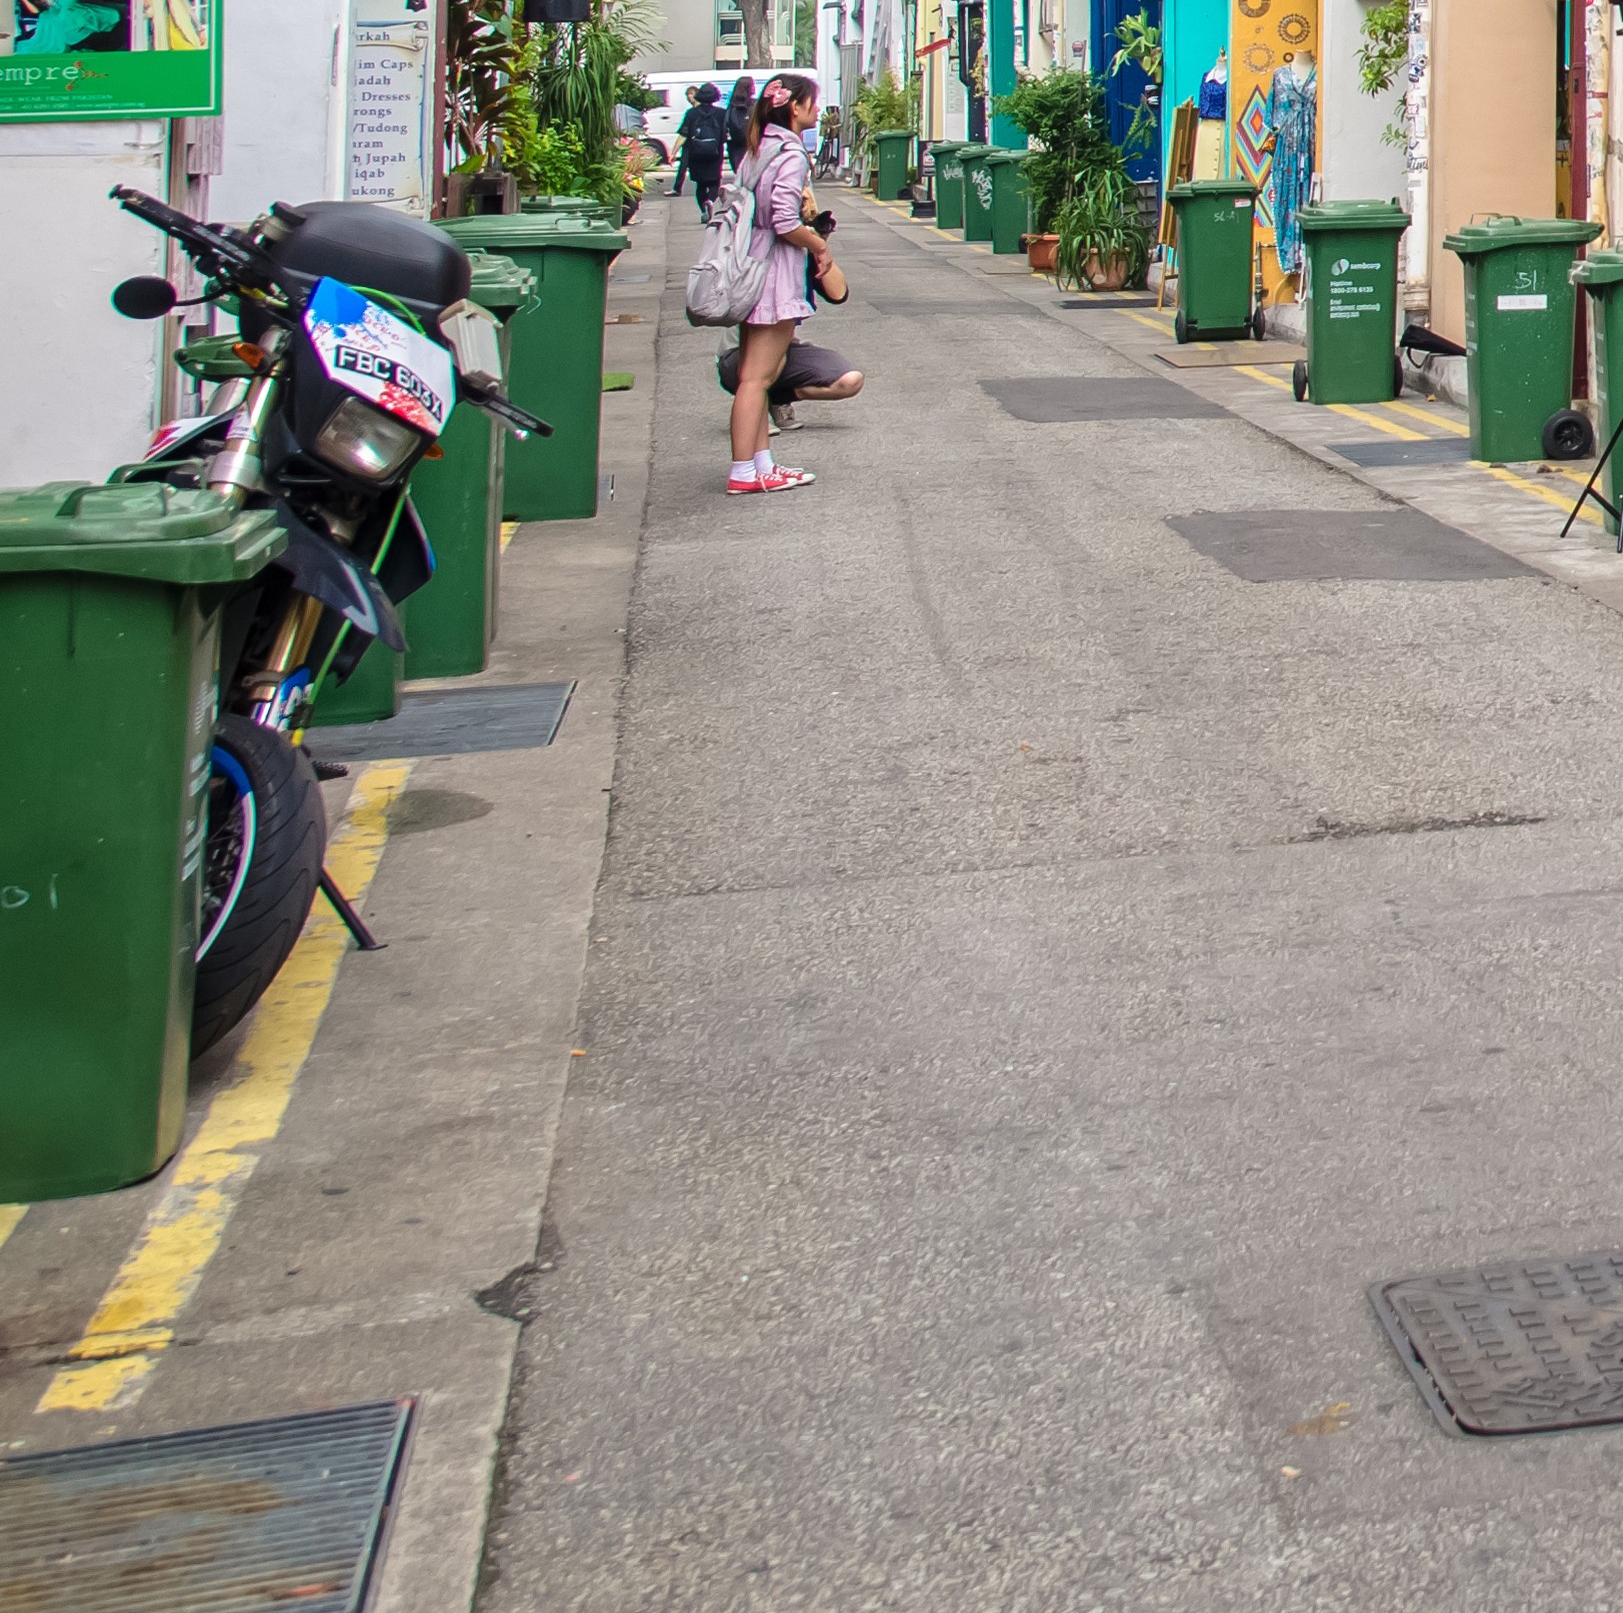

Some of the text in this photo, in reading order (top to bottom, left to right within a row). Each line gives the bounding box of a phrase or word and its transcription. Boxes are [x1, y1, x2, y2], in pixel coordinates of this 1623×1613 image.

[0, 65, 79, 86] mpre
[380, 58, 414, 72] Caps
[362, 91, 411, 102] Dresses
[1517, 270, 1537, 291] 51
[338, 344, 392, 380] FBC
